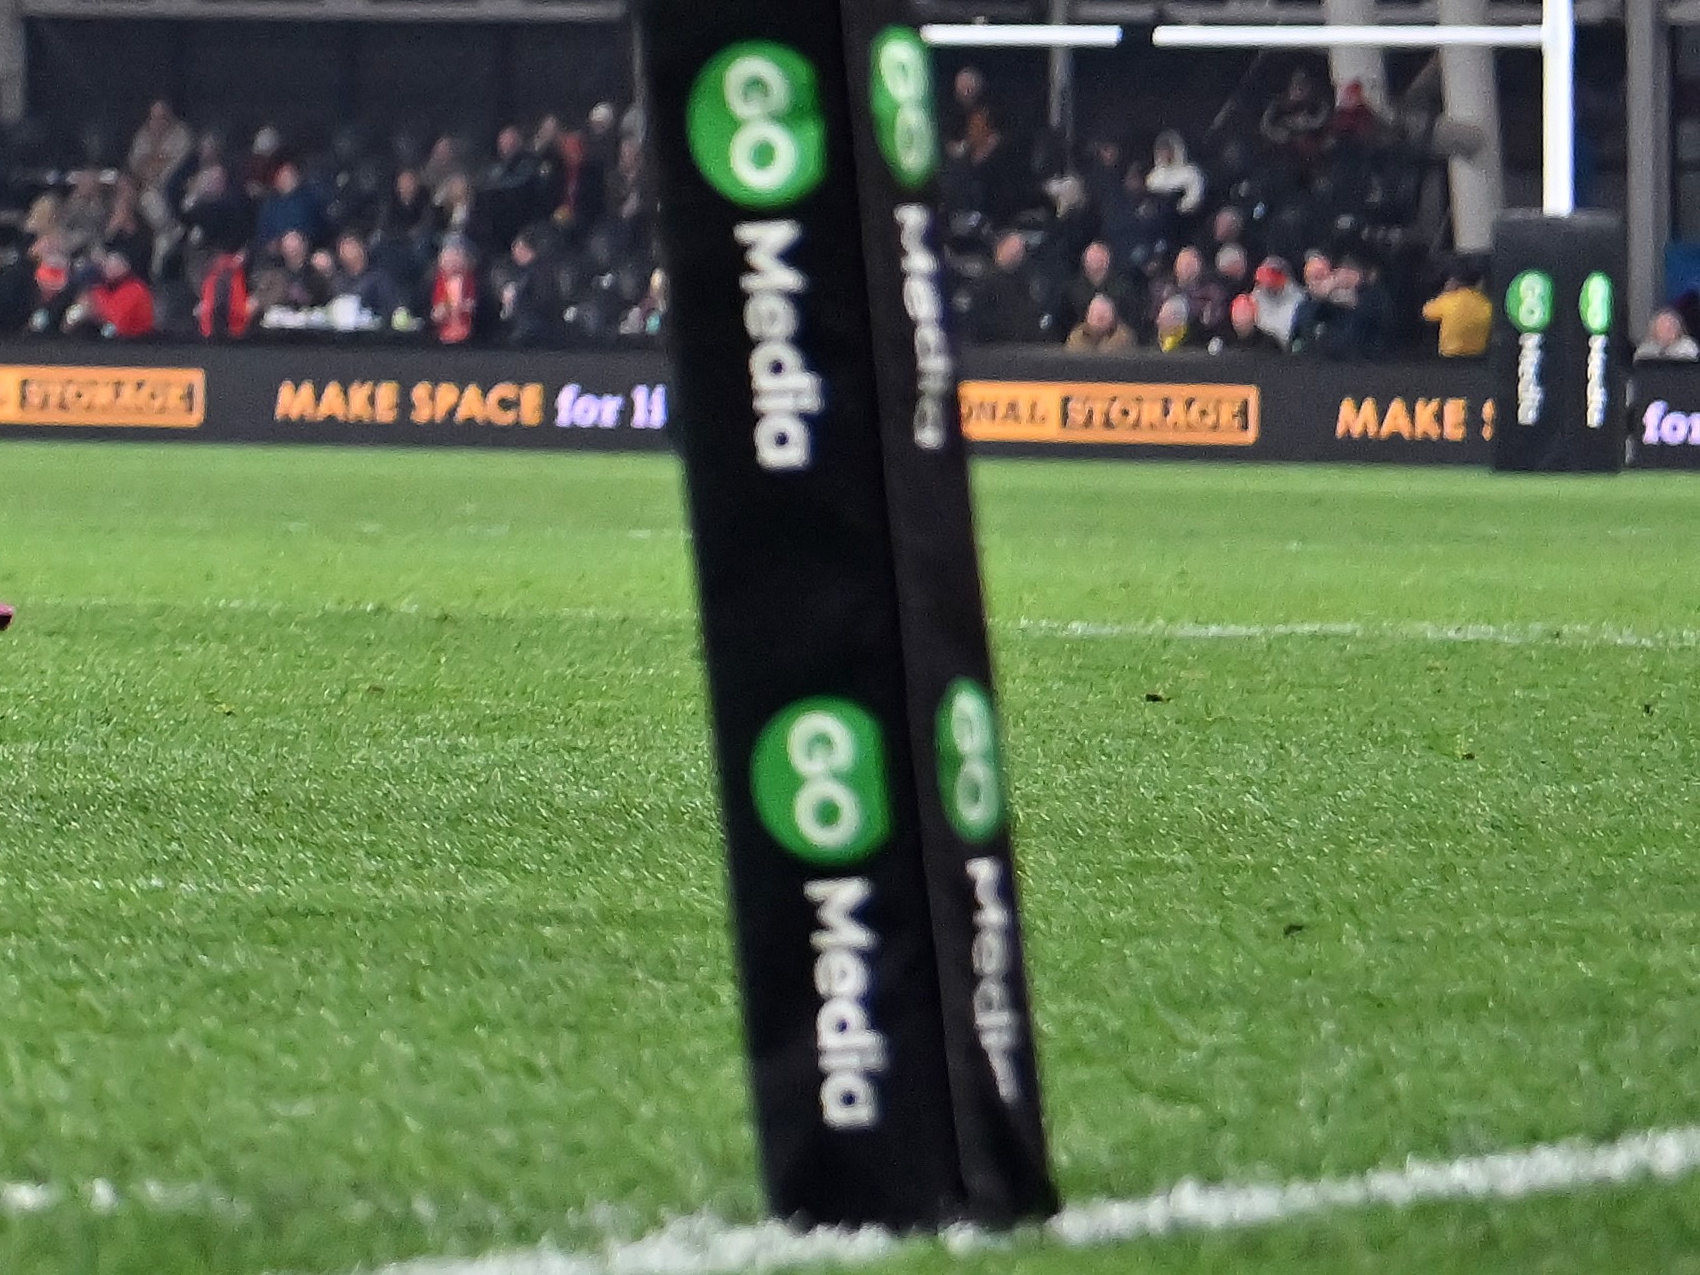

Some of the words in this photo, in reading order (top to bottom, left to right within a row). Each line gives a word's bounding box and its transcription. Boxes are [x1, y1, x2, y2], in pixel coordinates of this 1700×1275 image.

[724, 55, 798, 190] GO
[879, 37, 936, 174] GO
[733, 219, 825, 471] Media
[894, 203, 953, 450] Media
[274, 379, 401, 425] MAKE
[410, 380, 546, 427] SPACE
[554, 382, 625, 429] for
[1334, 394, 1468, 441] MAKE
[787, 710, 862, 849] GO
[949, 689, 1000, 825] GO
[803, 876, 890, 1131] Media
